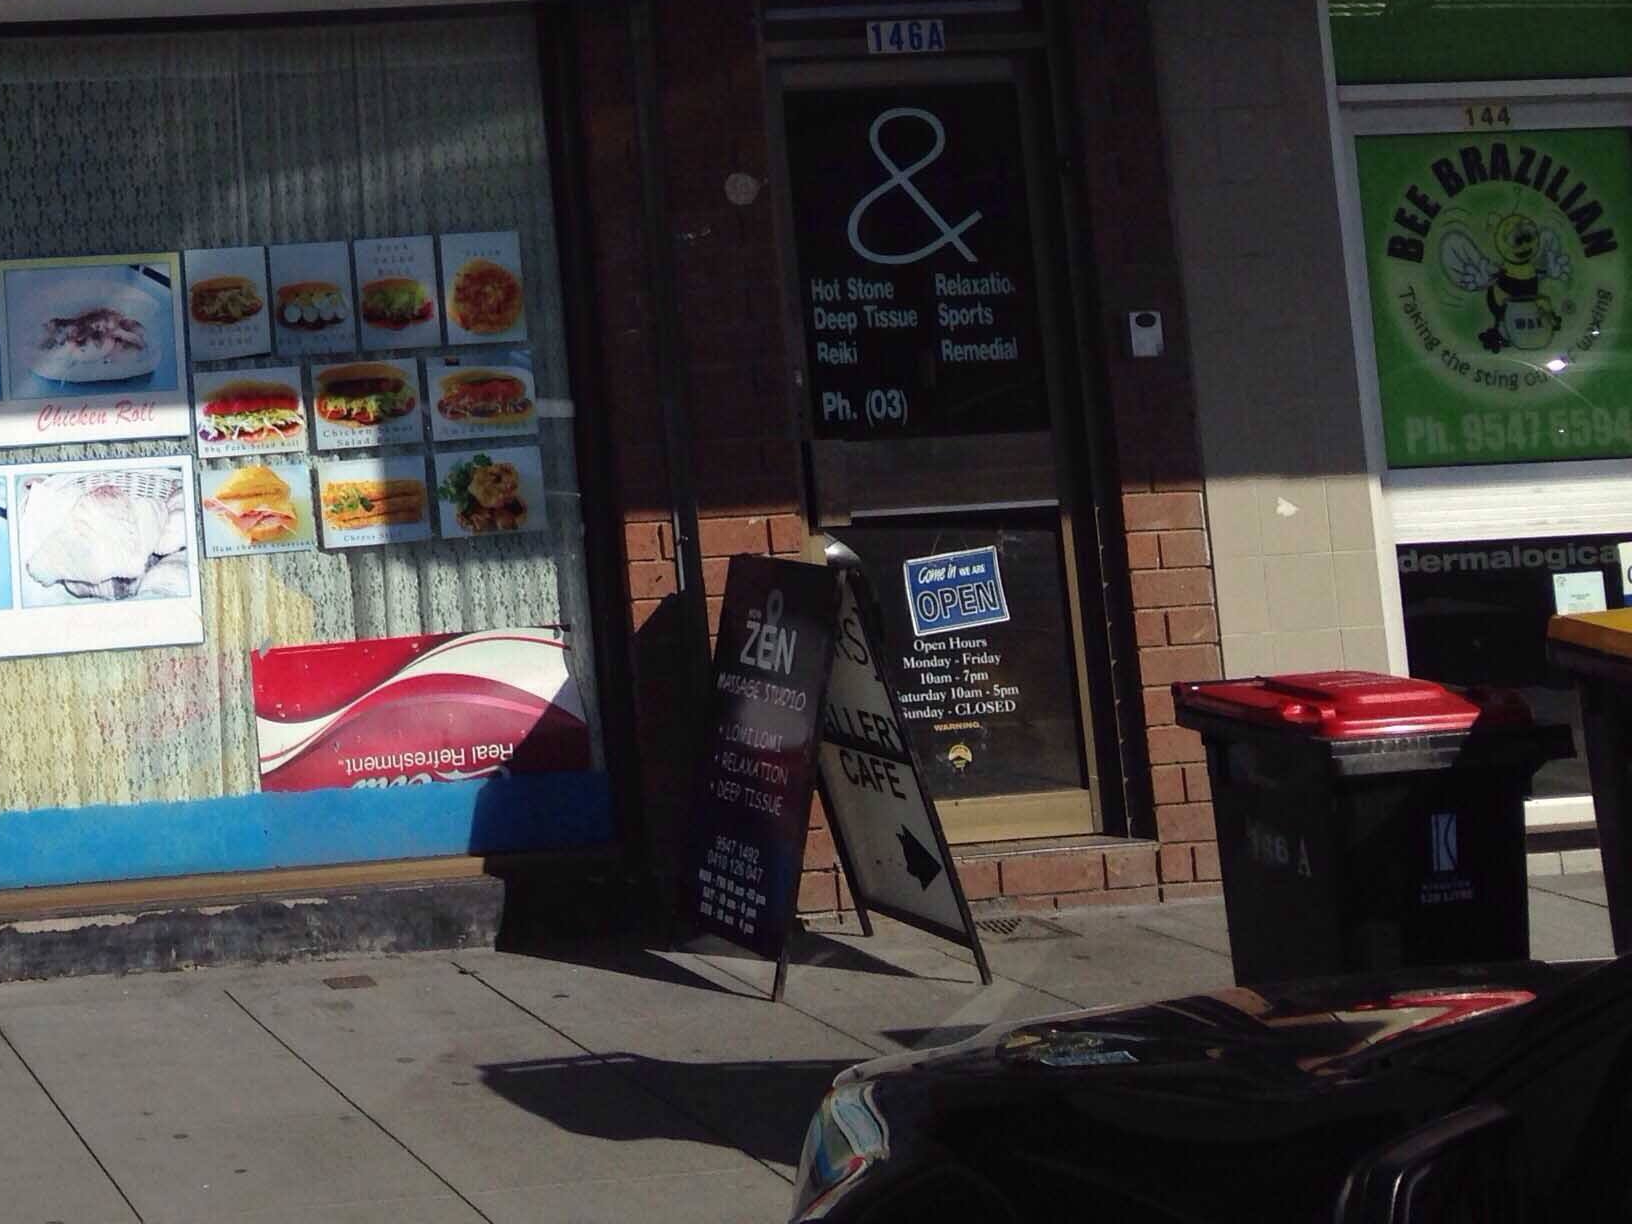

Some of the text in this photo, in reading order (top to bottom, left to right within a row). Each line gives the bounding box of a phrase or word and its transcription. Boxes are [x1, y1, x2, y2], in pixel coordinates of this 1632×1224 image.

[869, 21, 944, 51] 146A
[1466, 104, 1512, 128] 144
[846, 107, 984, 265] &
[1385, 142, 1620, 263] BEE BRAZILIAN
[811, 276, 895, 303] Hot Stone
[812, 304, 919, 336] Deep Tissue
[937, 301, 995, 332] Sports
[816, 340, 858, 366] Reiki
[940, 337, 1018, 363] Remedial
[1398, 284, 1441, 353] Taking
[1441, 349, 1471, 377] the
[1472, 368, 1519, 392] sting
[36, 399, 157, 432] Chicken Roll
[821, 388, 909, 427] Ph. (03)
[322, 427, 371, 439] Chicken
[1403, 414, 1457, 457] Ph.
[1398, 542, 1619, 573] dermalogica
[918, 566, 946, 585] Come
[947, 563, 956, 579] in
[916, 579, 1001, 623] OPEN
[739, 618, 799, 675] ZEN
[913, 636, 988, 653] Open Hours
[902, 655, 951, 670] Monday
[962, 652, 1002, 665] Friday
[920, 672, 953, 685] 10am
[963, 669, 989, 684] 7pm
[950, 686, 983, 700] 10am
[992, 683, 1020, 699] 5pm
[762, 682, 807, 712] STUDIO
[954, 699, 1017, 716] CLOSED
[471, 743, 515, 766] Real
[721, 751, 790, 785] RELAXATION
[839, 748, 907, 801] CAFE
[716, 778, 785, 817] DEEP TISSUE
